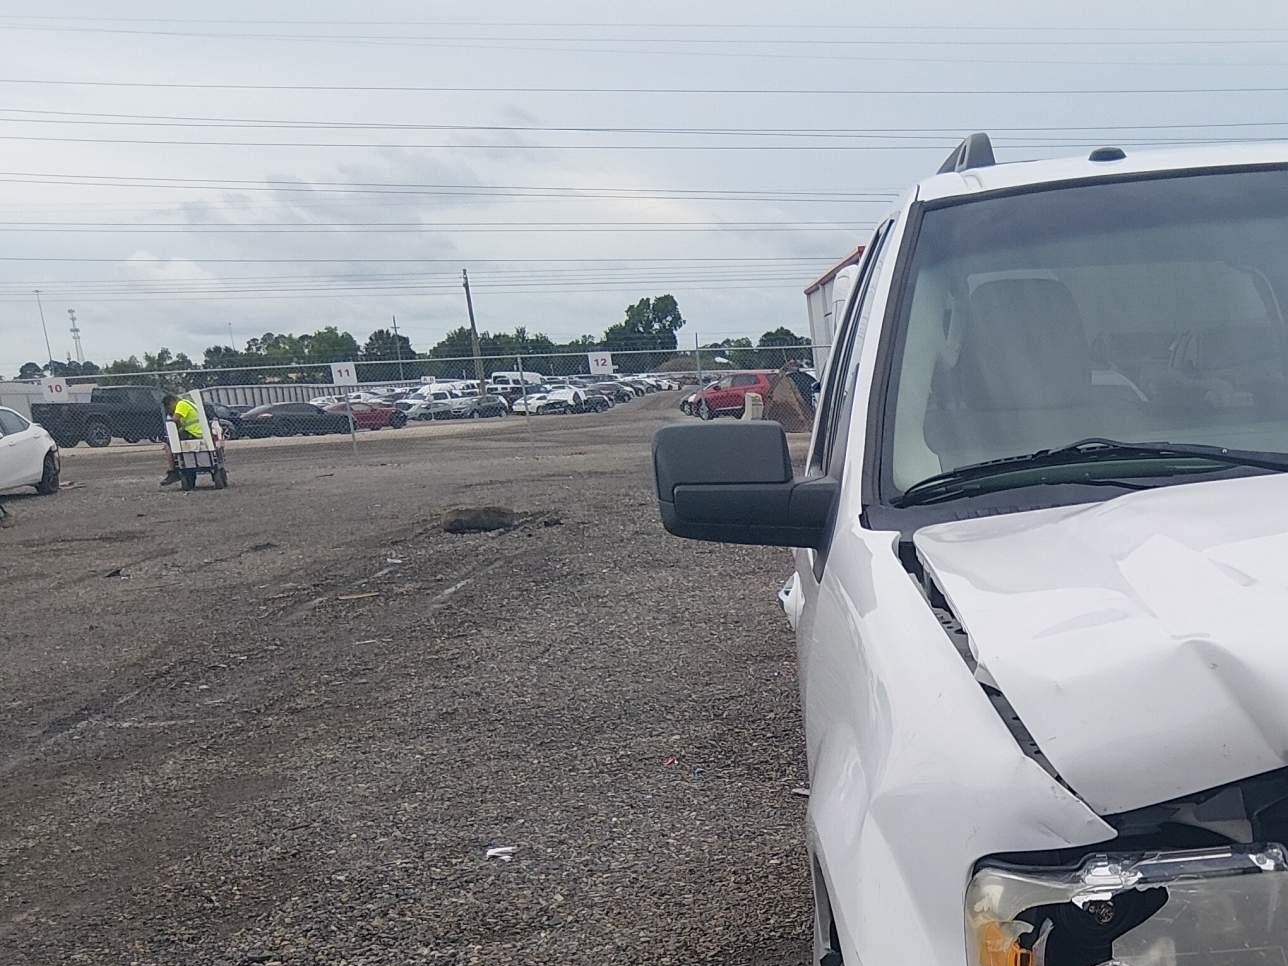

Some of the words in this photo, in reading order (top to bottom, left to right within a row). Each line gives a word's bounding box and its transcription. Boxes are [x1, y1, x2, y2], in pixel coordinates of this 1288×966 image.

[594, 358, 608, 367] 12
[337, 369, 350, 377] 11
[48, 384, 62, 393] 10
